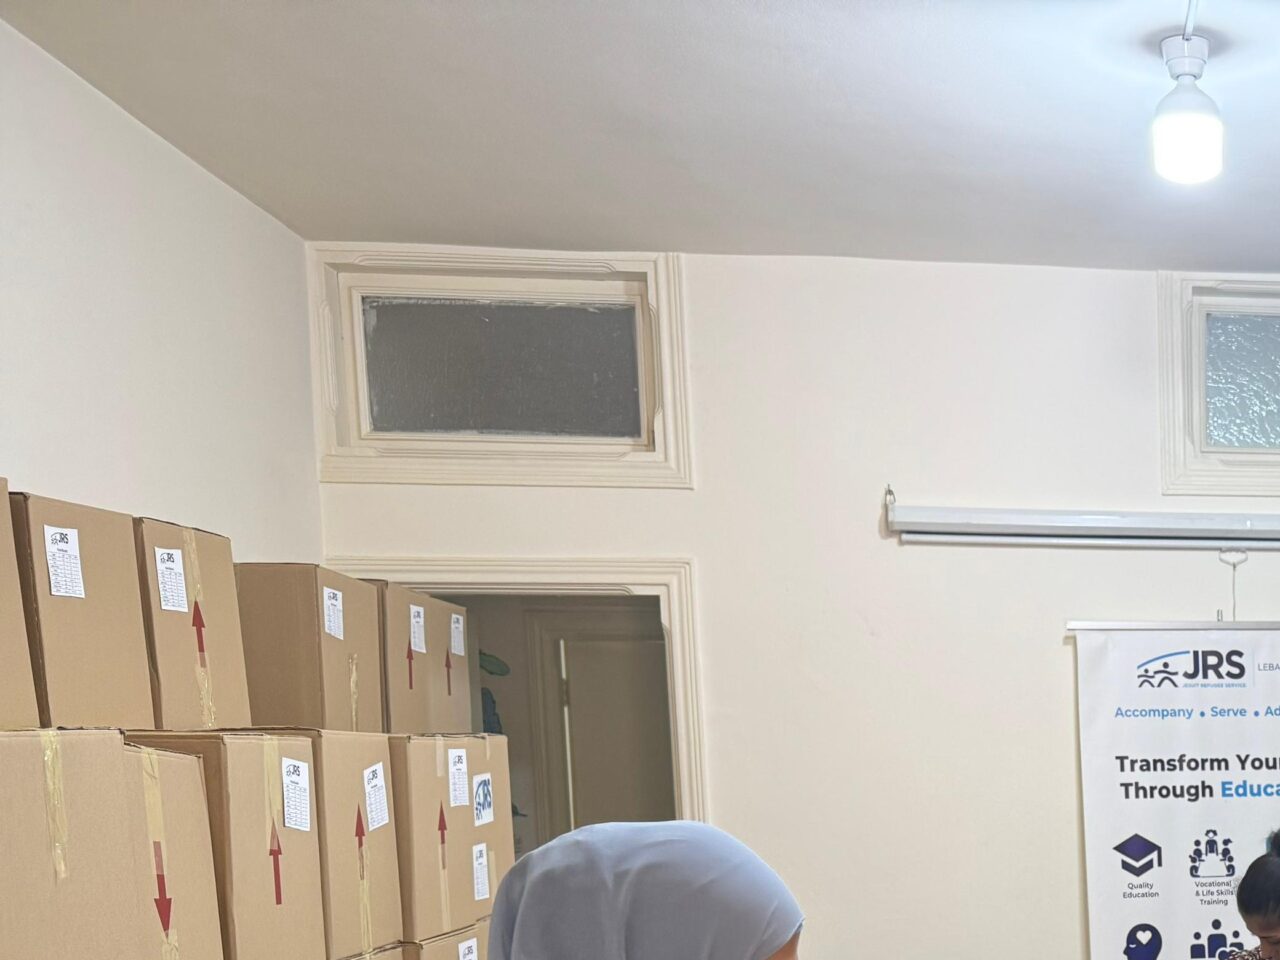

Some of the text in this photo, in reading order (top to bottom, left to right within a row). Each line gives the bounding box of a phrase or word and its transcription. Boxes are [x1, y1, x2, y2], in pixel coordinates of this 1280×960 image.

[1182, 650, 1245, 680] JRS
[1115, 707, 1194, 720] Accompany
[1210, 706, 1247, 717] Serve
[1115, 754, 1229, 772] Transform
[1120, 781, 1214, 803] Through
[1127, 882, 1154, 890] Quality
[1195, 880, 1232, 888] Vocational
[1123, 891, 1159, 899] Education
[1202, 889, 1215, 897] Life
[1200, 898, 1228, 906] Training
